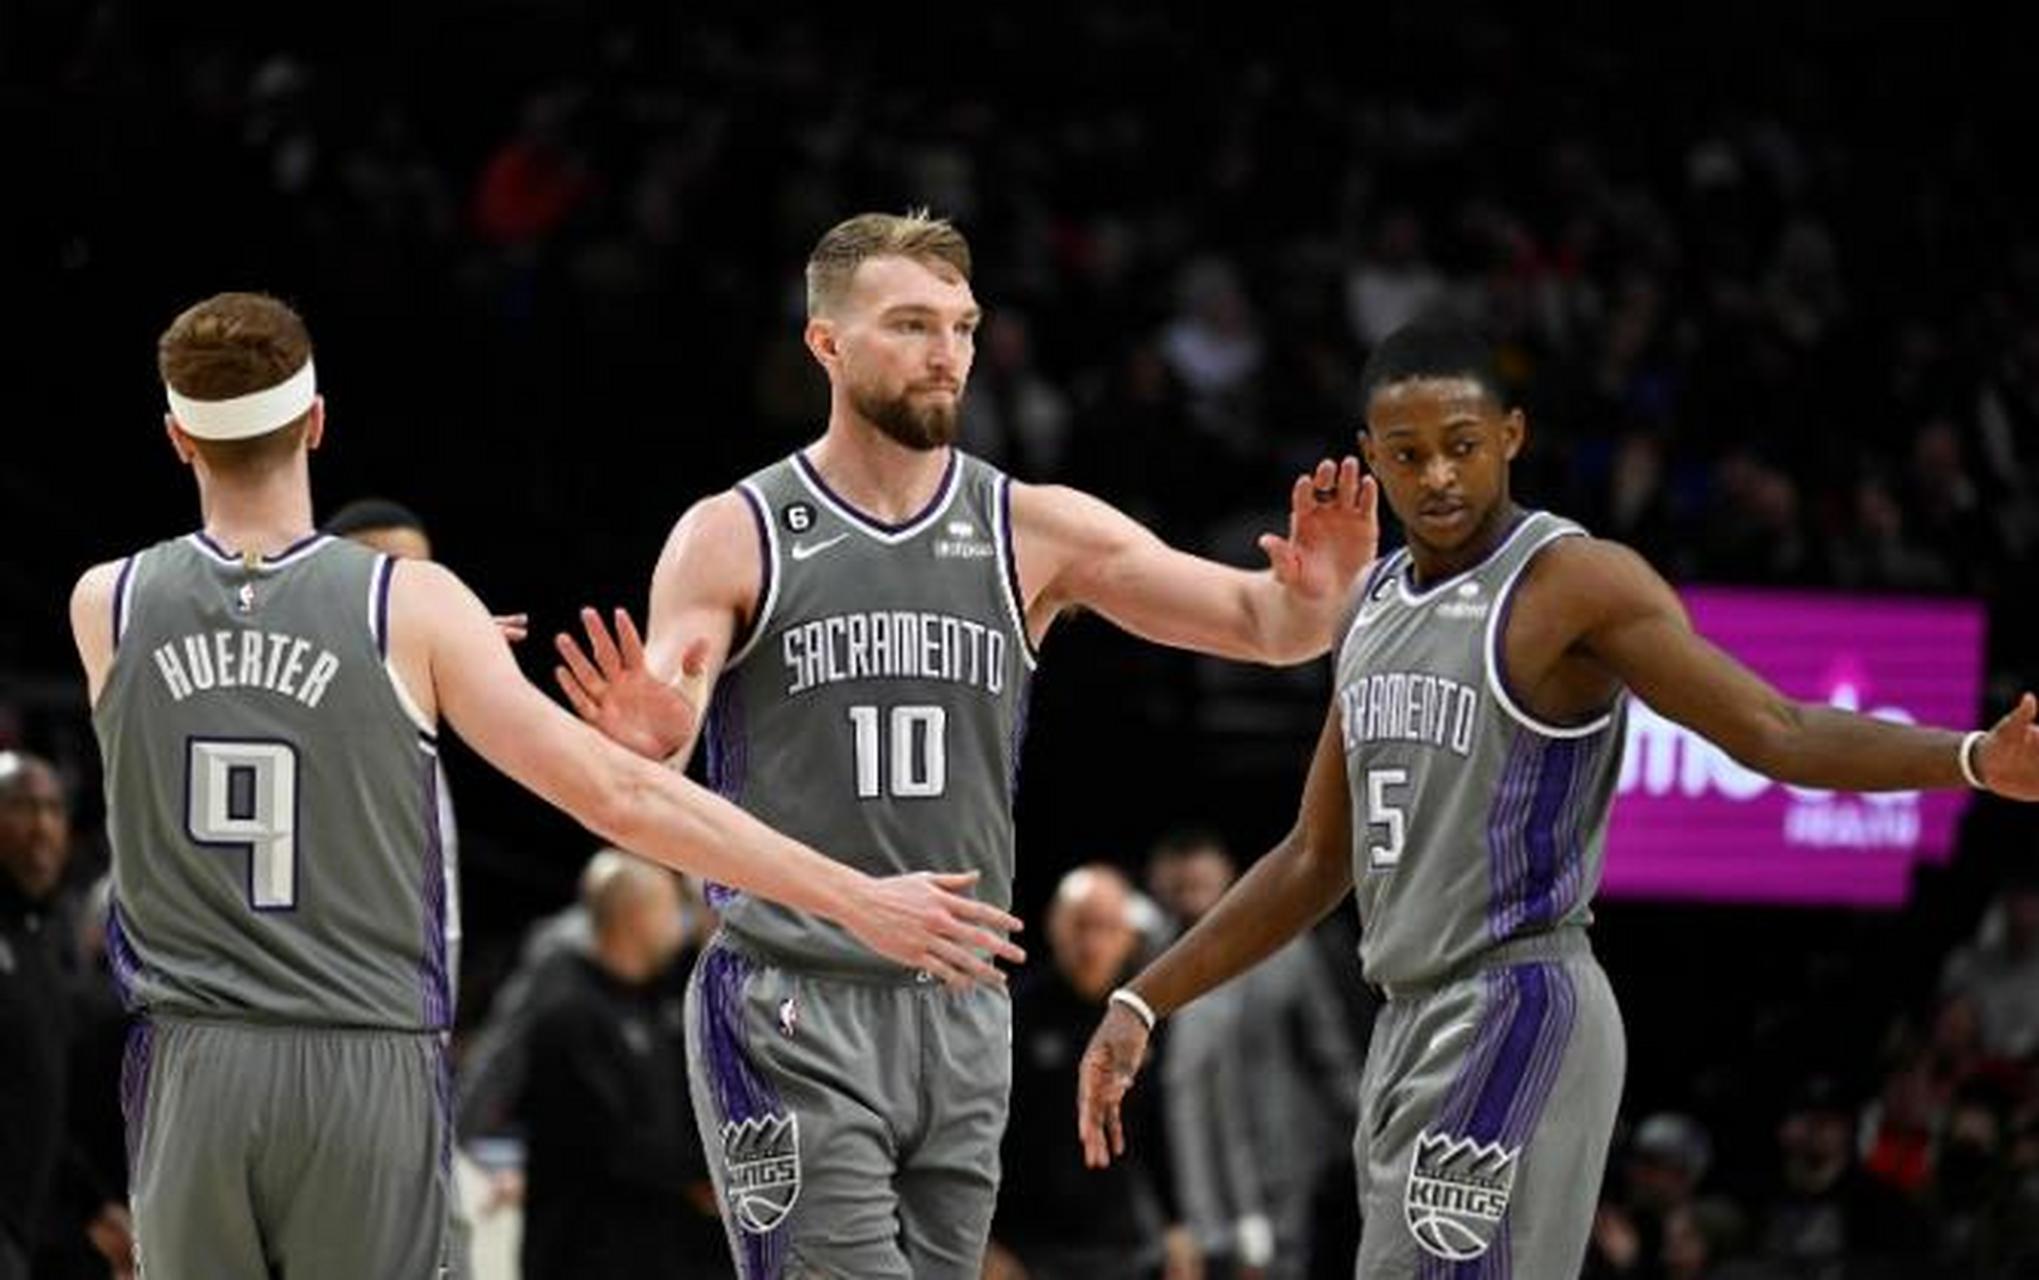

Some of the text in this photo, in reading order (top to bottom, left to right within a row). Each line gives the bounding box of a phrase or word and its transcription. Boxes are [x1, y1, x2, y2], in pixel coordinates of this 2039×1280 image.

[788, 505, 809, 530] 6
[153, 629, 340, 708] HUERTER
[783, 611, 1005, 695] SACRAMENTO
[849, 705, 947, 798] 10
[186, 735, 297, 911] 9
[1366, 768, 1407, 868] 5
[1408, 1180, 1508, 1217] KINGS
